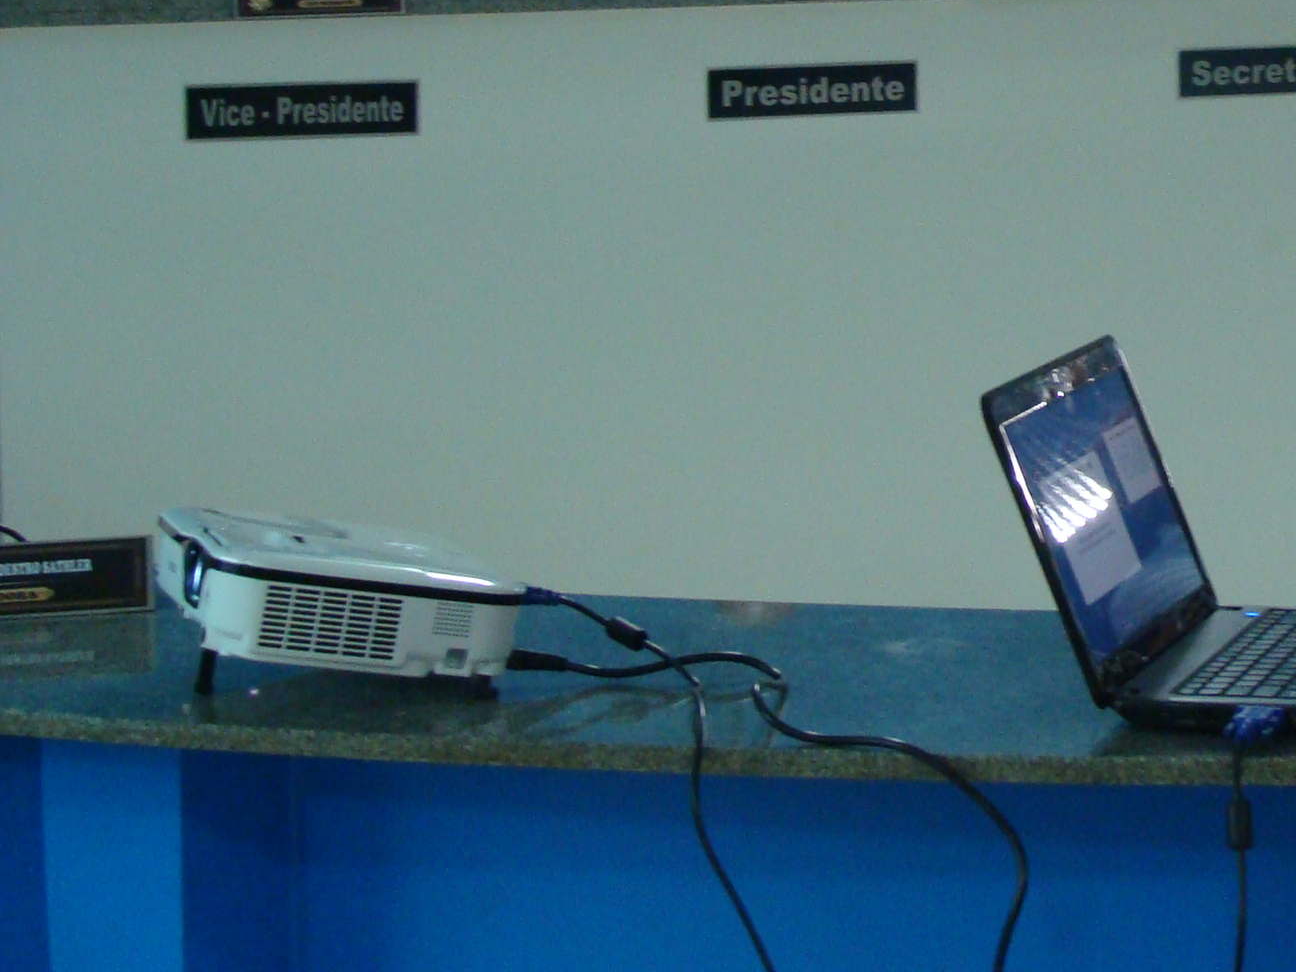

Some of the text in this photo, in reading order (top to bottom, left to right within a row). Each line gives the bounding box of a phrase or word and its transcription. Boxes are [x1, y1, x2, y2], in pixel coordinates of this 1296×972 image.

[721, 76, 905, 108] Presidente
[201, 98, 255, 127] Vice
[276, 94, 405, 125] Presidente
